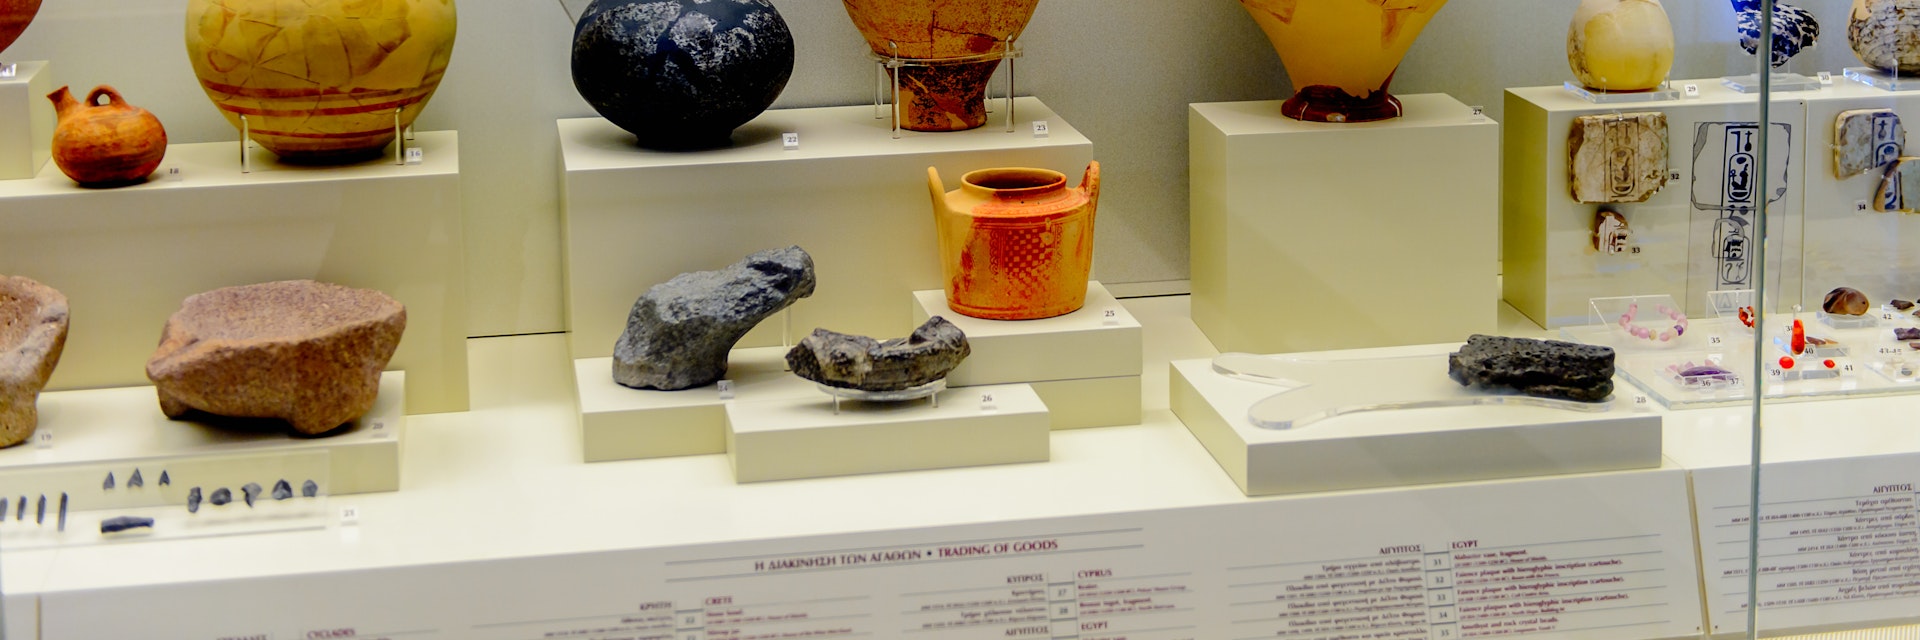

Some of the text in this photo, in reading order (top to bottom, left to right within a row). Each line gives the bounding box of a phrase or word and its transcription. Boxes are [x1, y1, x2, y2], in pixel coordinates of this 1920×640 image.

[1472, 108, 1483, 116] 27
[1631, 246, 1641, 254] 33
[981, 394, 992, 402] 26
[41, 433, 52, 441] 19
[1873, 483, 1912, 494] ΑΙΓΥΠΤΟΣ
[1452, 540, 1478, 549] EGYPT
[1379, 544, 1421, 555] ΑΙΓΥΠΤΟΣ
[754, 539, 1058, 571] Η ΔΙΑΚΙΝΗΣΗ ΤΩΝ ΑΓΑΘΩΝ TRADING OF GOODS
[1077, 569, 1112, 578] CYPRUS
[1006, 573, 1044, 584] ΚΥΠΡΟΣ
[1504, 584, 1517, 592] with
[705, 596, 732, 605] CRETE
[1437, 593, 1446, 601] 33
[1080, 621, 1108, 630] EGYPT
[1503, 619, 1517, 627] rock
[1518, 618, 1538, 626] crystal
[1005, 625, 1049, 636] ΑΙΓΥΠΤΟΣ
